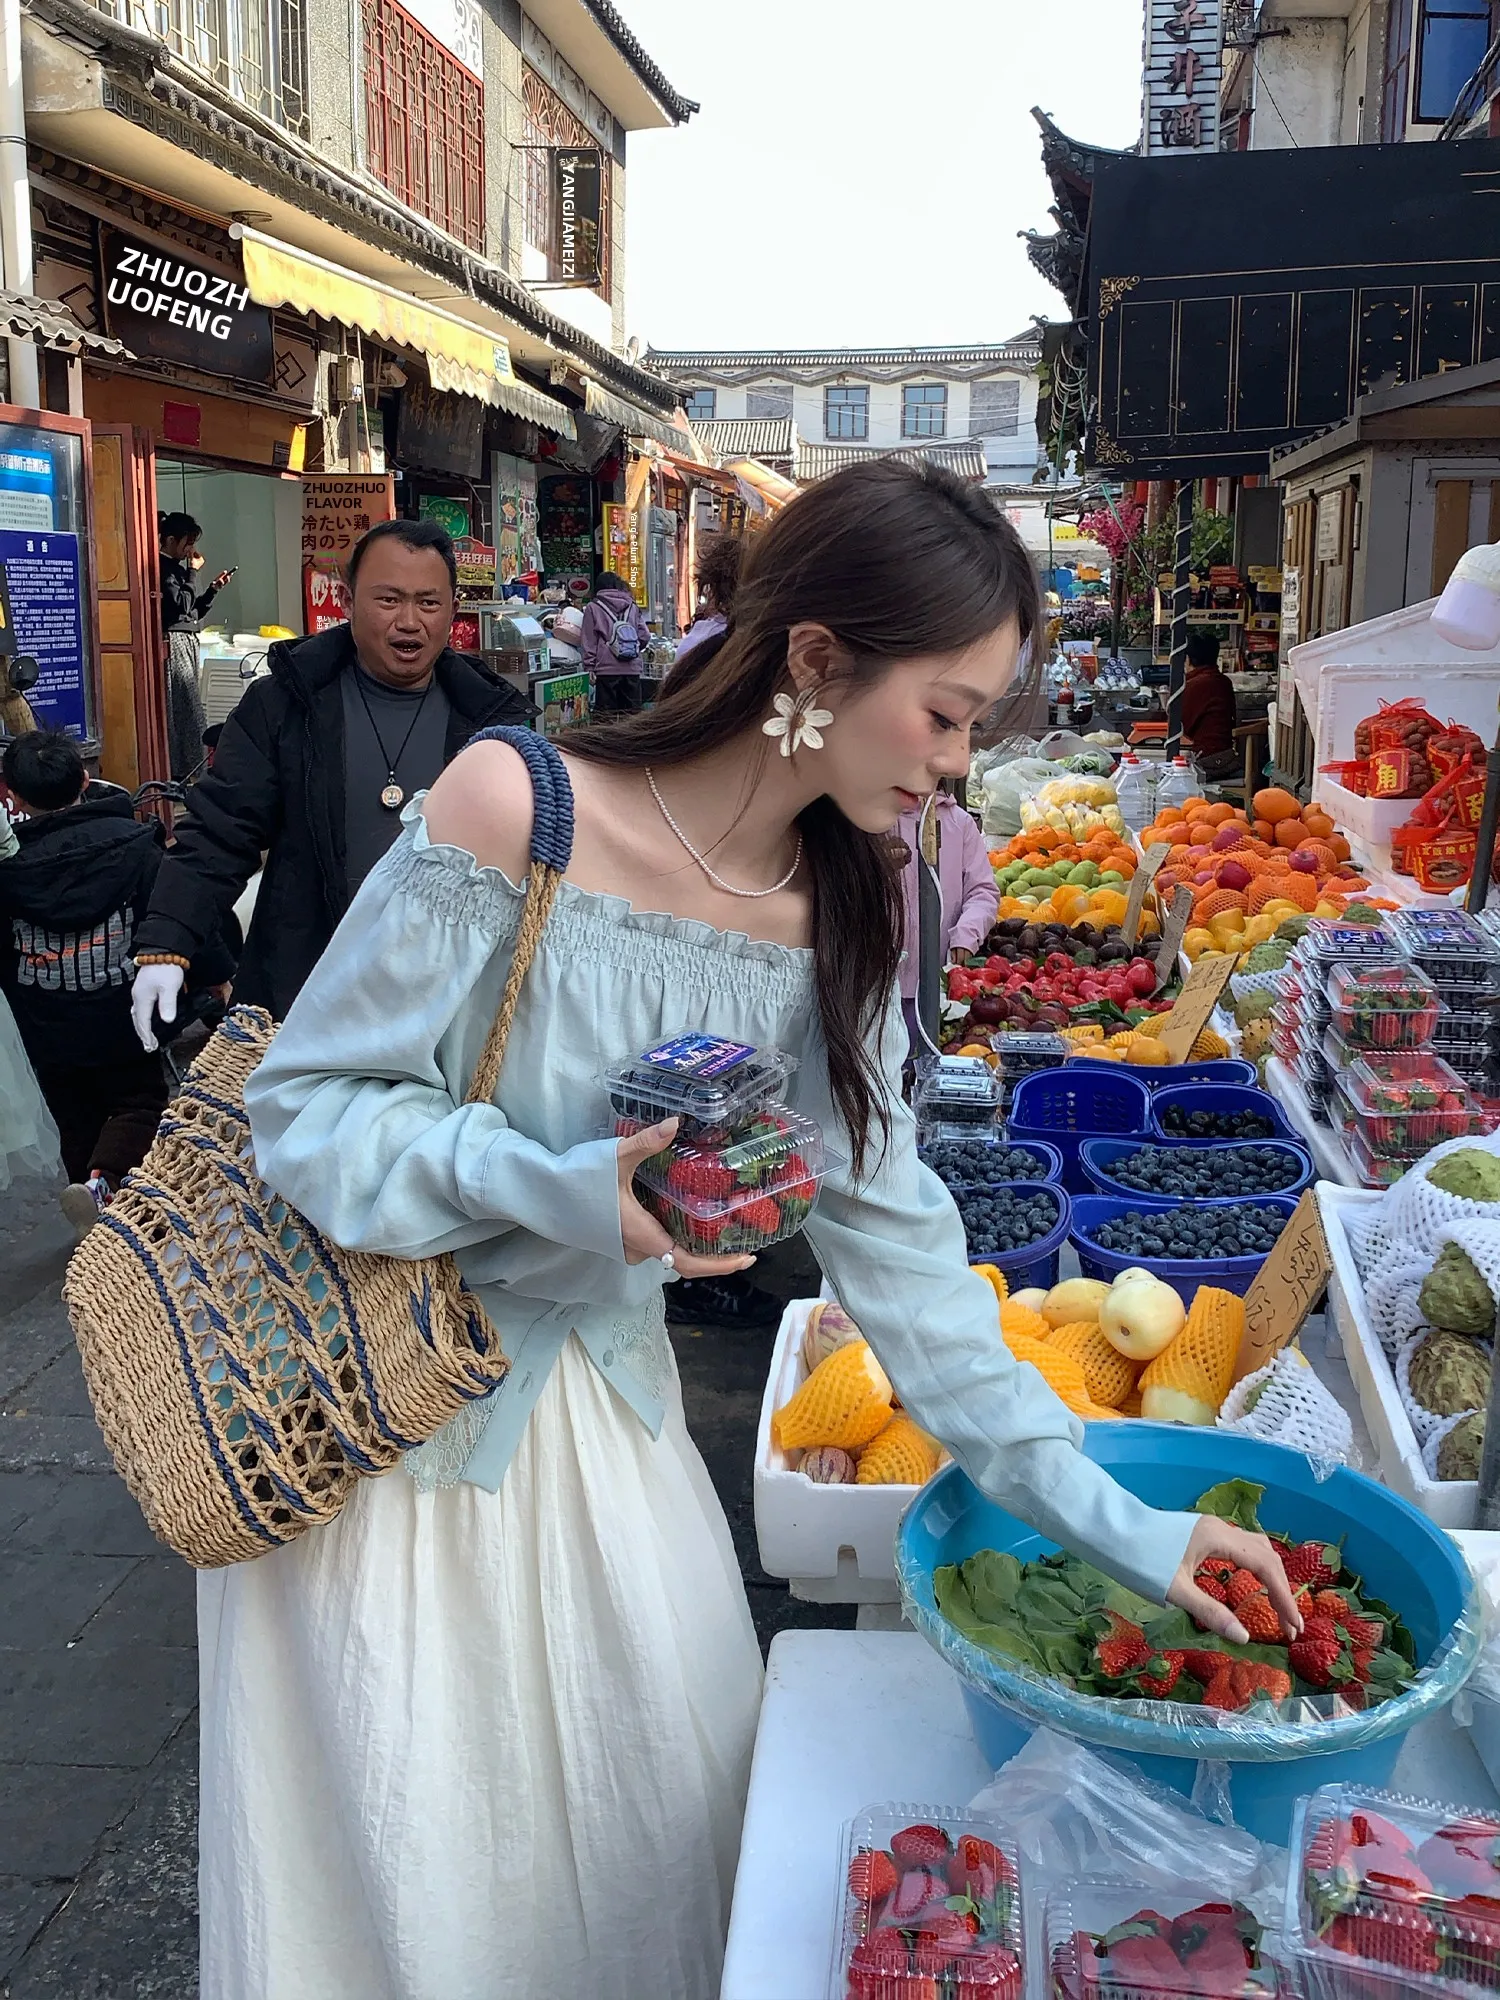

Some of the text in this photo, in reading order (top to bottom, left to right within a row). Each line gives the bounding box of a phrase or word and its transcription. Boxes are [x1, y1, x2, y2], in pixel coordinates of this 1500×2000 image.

[562, 162, 575, 279] YANGJIAMEIZI
[116, 246, 250, 311] ZHUOZH
[107, 278, 233, 340] UOFENG
[302, 482, 386, 494] ZHUOZHUO
[306, 497, 362, 509] FLAVOR
[301, 514, 370, 531] 冷たい鶏
[302, 534, 367, 550] 肉のラ
[628, 511, 638, 588] Yang's Plum Shop
[301, 554, 317, 568] ス
